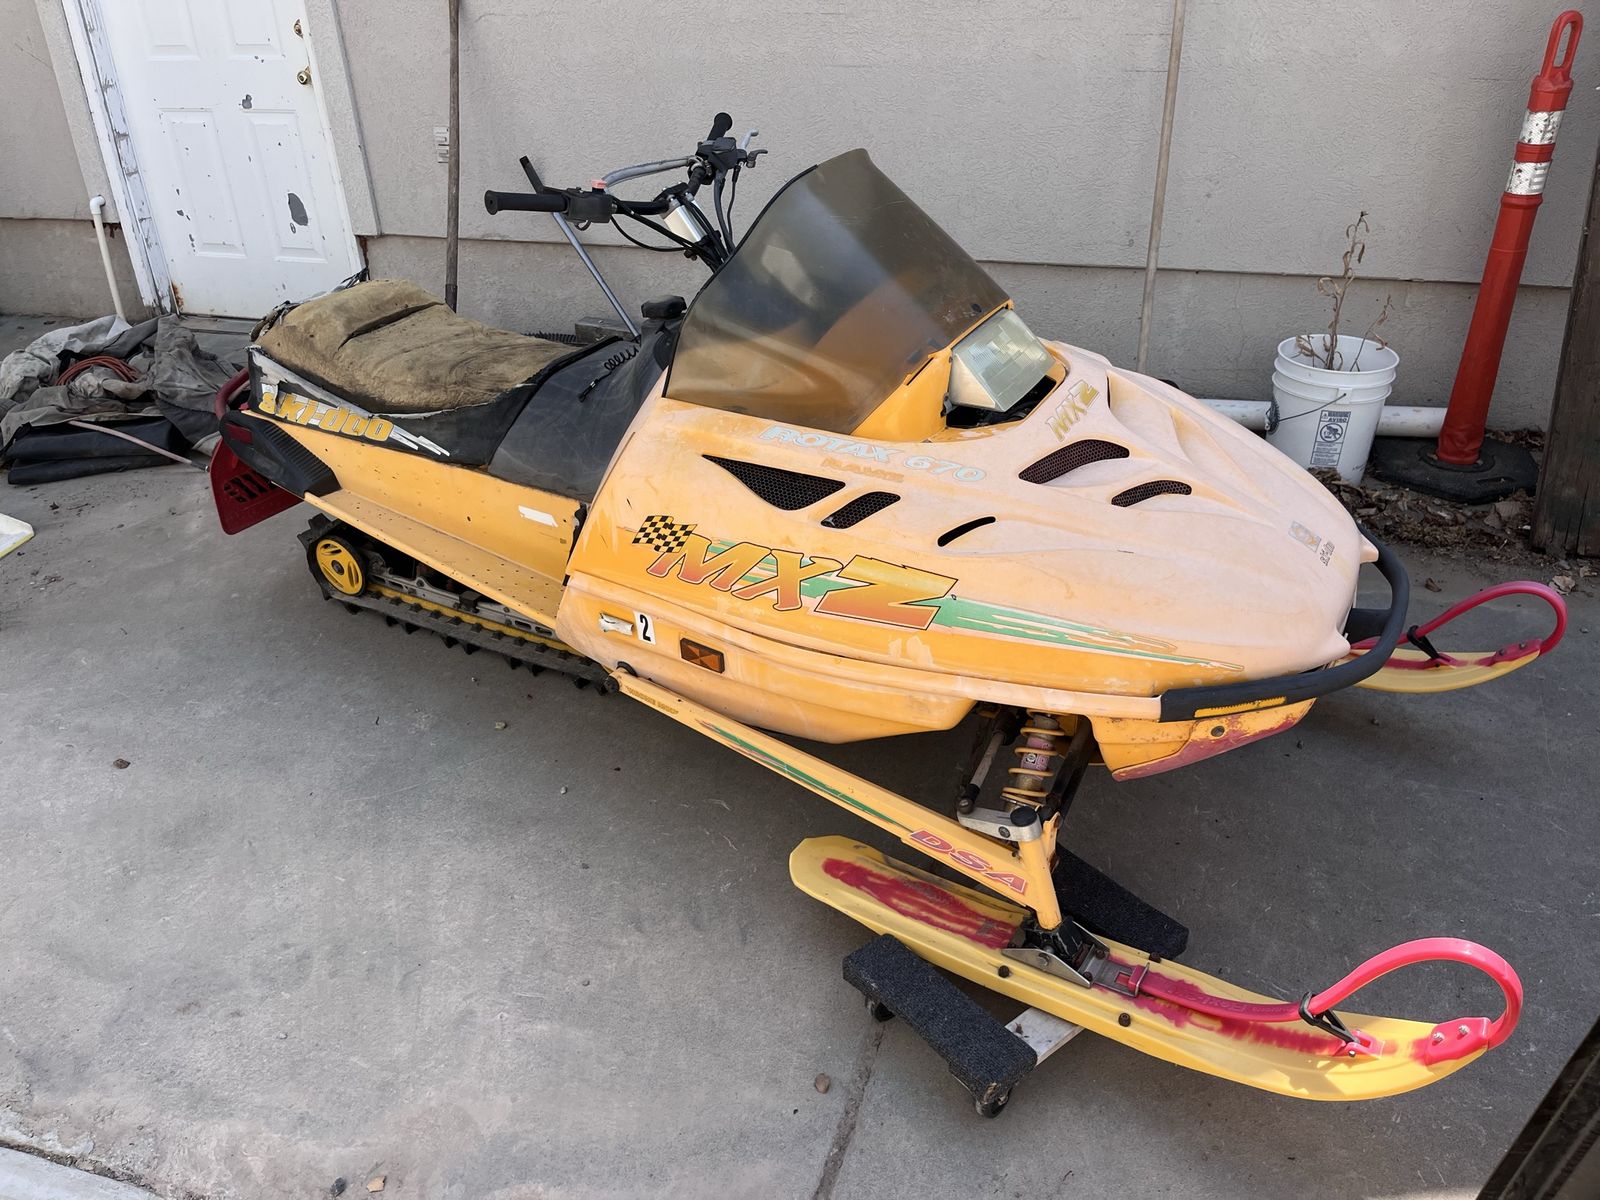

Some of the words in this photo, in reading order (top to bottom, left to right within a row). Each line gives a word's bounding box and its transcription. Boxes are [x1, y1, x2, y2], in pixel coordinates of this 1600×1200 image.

[1045, 379, 1100, 442] MXZ
[758, 425, 905, 463] ROTAX
[903, 455, 987, 482] 670
[646, 532, 959, 631] MXZ
[639, 613, 652, 642] 2
[910, 830, 1027, 894] DSA
